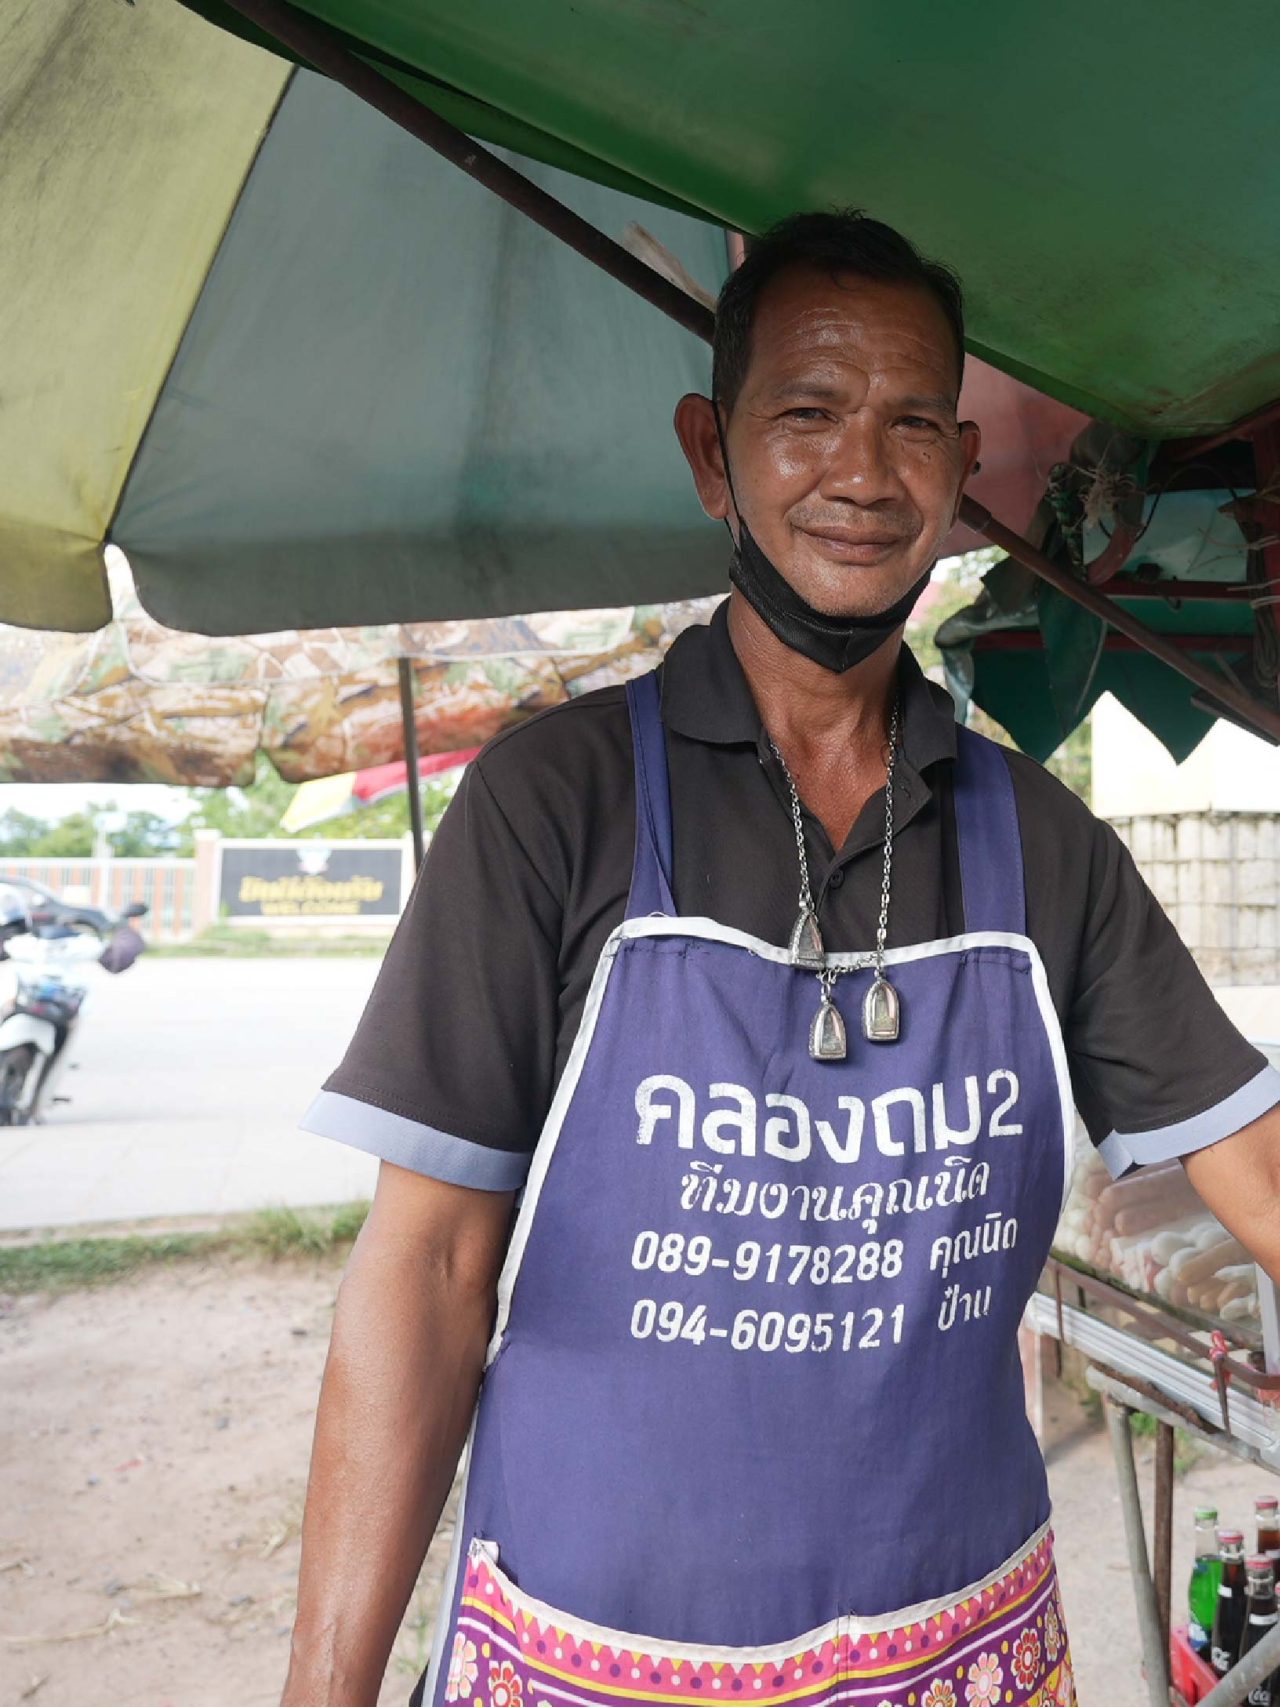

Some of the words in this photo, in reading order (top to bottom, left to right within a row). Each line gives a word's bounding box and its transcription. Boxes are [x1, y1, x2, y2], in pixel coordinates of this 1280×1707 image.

[634, 1068, 1024, 1163] คลองถม2
[679, 1155, 991, 1235] ทีมงานคุณนิด
[630, 1230, 905, 1286] 089-9178288
[928, 1211, 1018, 1279] คุณนิด
[630, 1298, 905, 1354] 094-6095121
